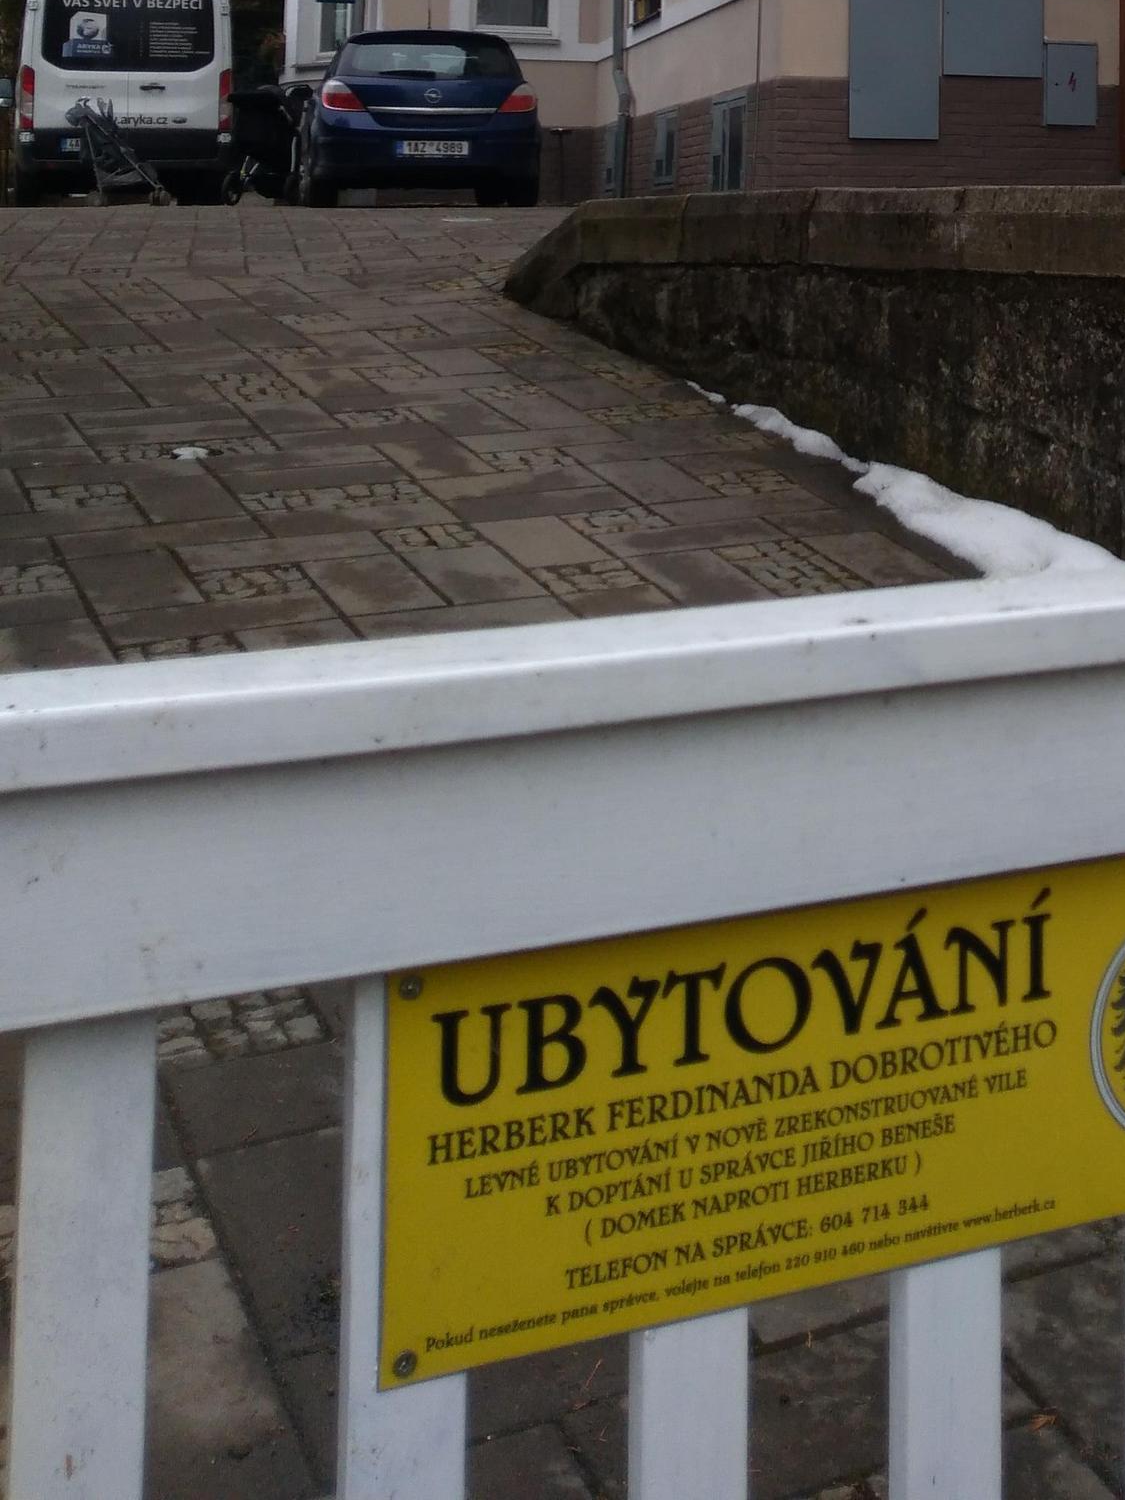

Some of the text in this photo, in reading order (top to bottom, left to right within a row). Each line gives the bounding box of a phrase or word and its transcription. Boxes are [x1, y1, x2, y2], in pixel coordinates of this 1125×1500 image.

[407, 142, 427, 153] 1AZ
[432, 888, 1052, 1108] UBYTOVÁNÍ
[427, 1019, 1058, 1167] HERBERK FERDINANDA DOBROTIVÉHO
[464, 1068, 1028, 1199] LEVNÉ UBYTOVÁNÍ V NOVĚ ZREKONSTRUOVANÉ VILE
[545, 1113, 956, 1218] K DOPTÁNÍ U SPRÁVCE JIŘÍHO BENEŠE
[599, 1201, 687, 1239] DOMEK
[692, 1179, 790, 1218] NAPROTI
[795, 1154, 908, 1197] HERBERKU
[425, 1326, 474, 1351] Pokud
[479, 1313, 557, 1341] neseženete
[561, 1304, 598, 1327] pana
[714, 1274, 731, 1287] na
[735, 1262, 781, 1284] telefon
[868, 1233, 900, 1251] nebo
[565, 1193, 930, 1290] TELEFON NA SPRÁVCE: 604 714 344
